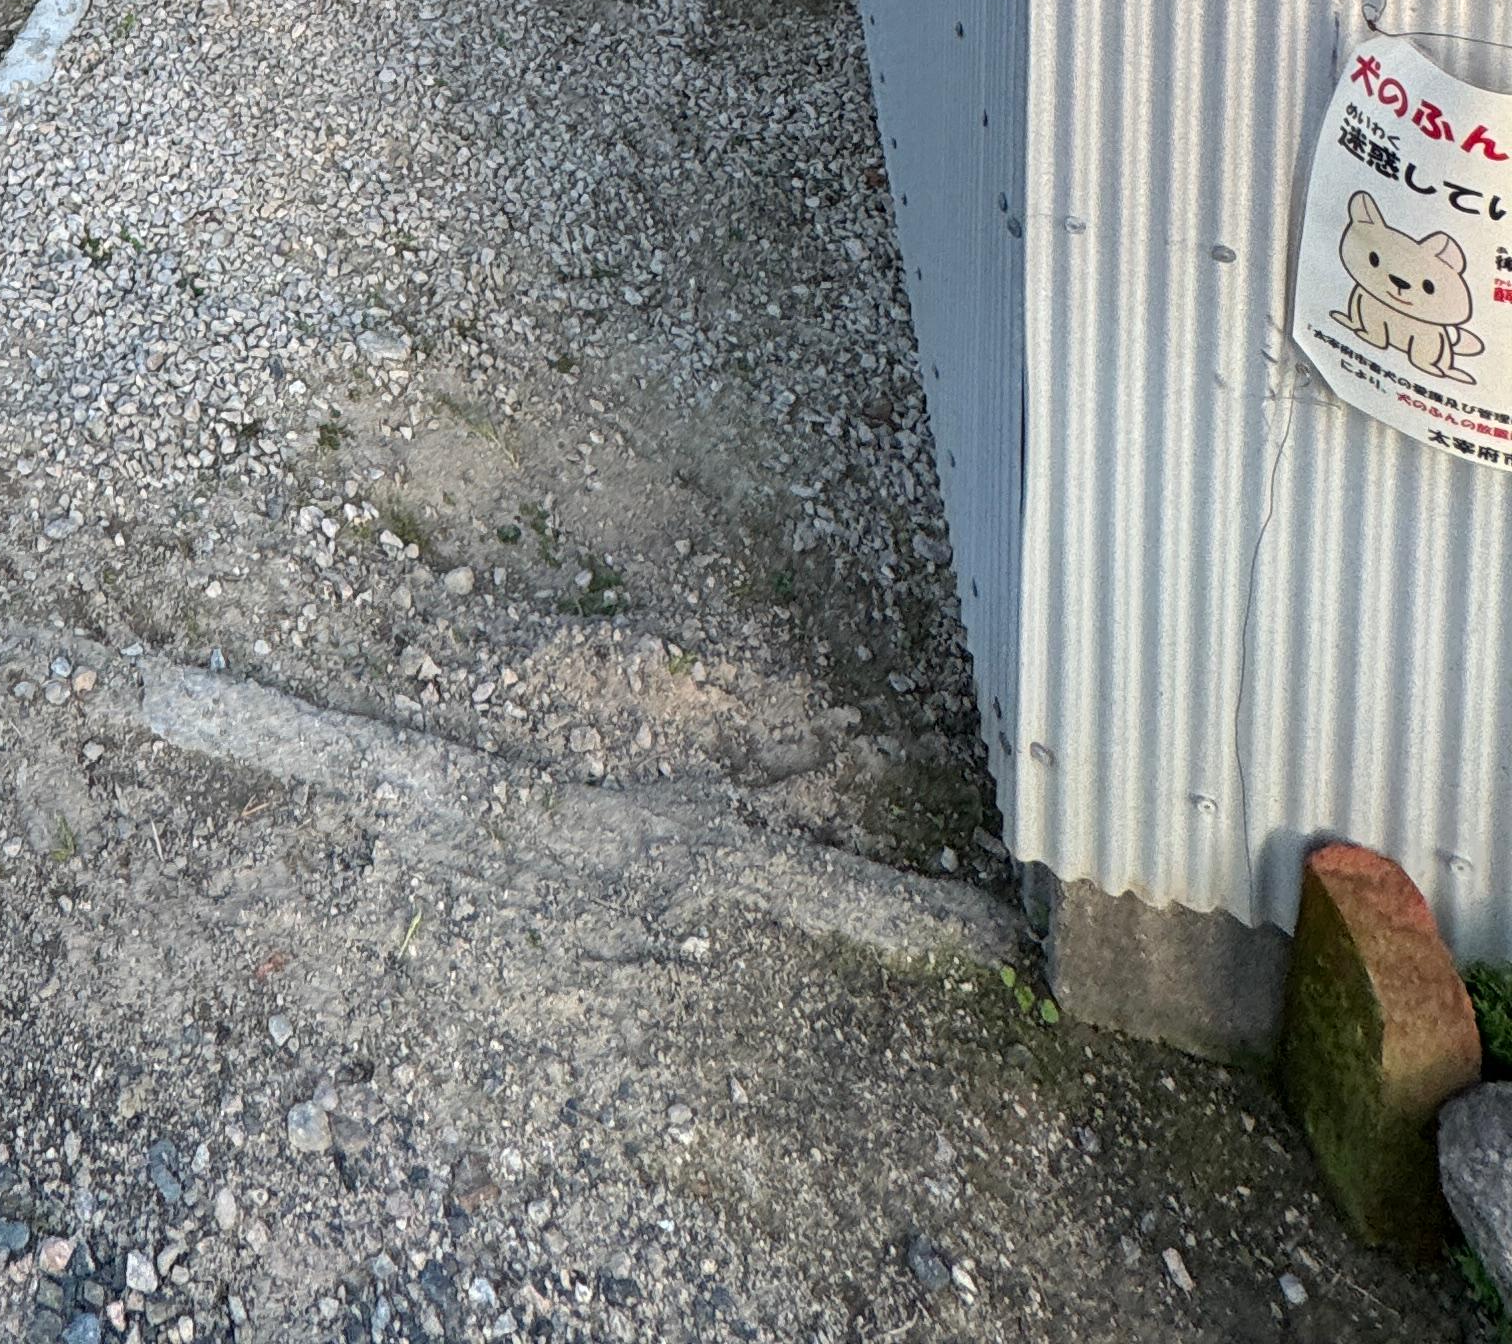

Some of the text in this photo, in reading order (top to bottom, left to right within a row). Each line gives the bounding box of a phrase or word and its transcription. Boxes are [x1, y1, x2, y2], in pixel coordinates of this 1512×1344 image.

[1346, 102, 1400, 151] めいわく
[1350, 55, 1510, 162] 犬のふん
